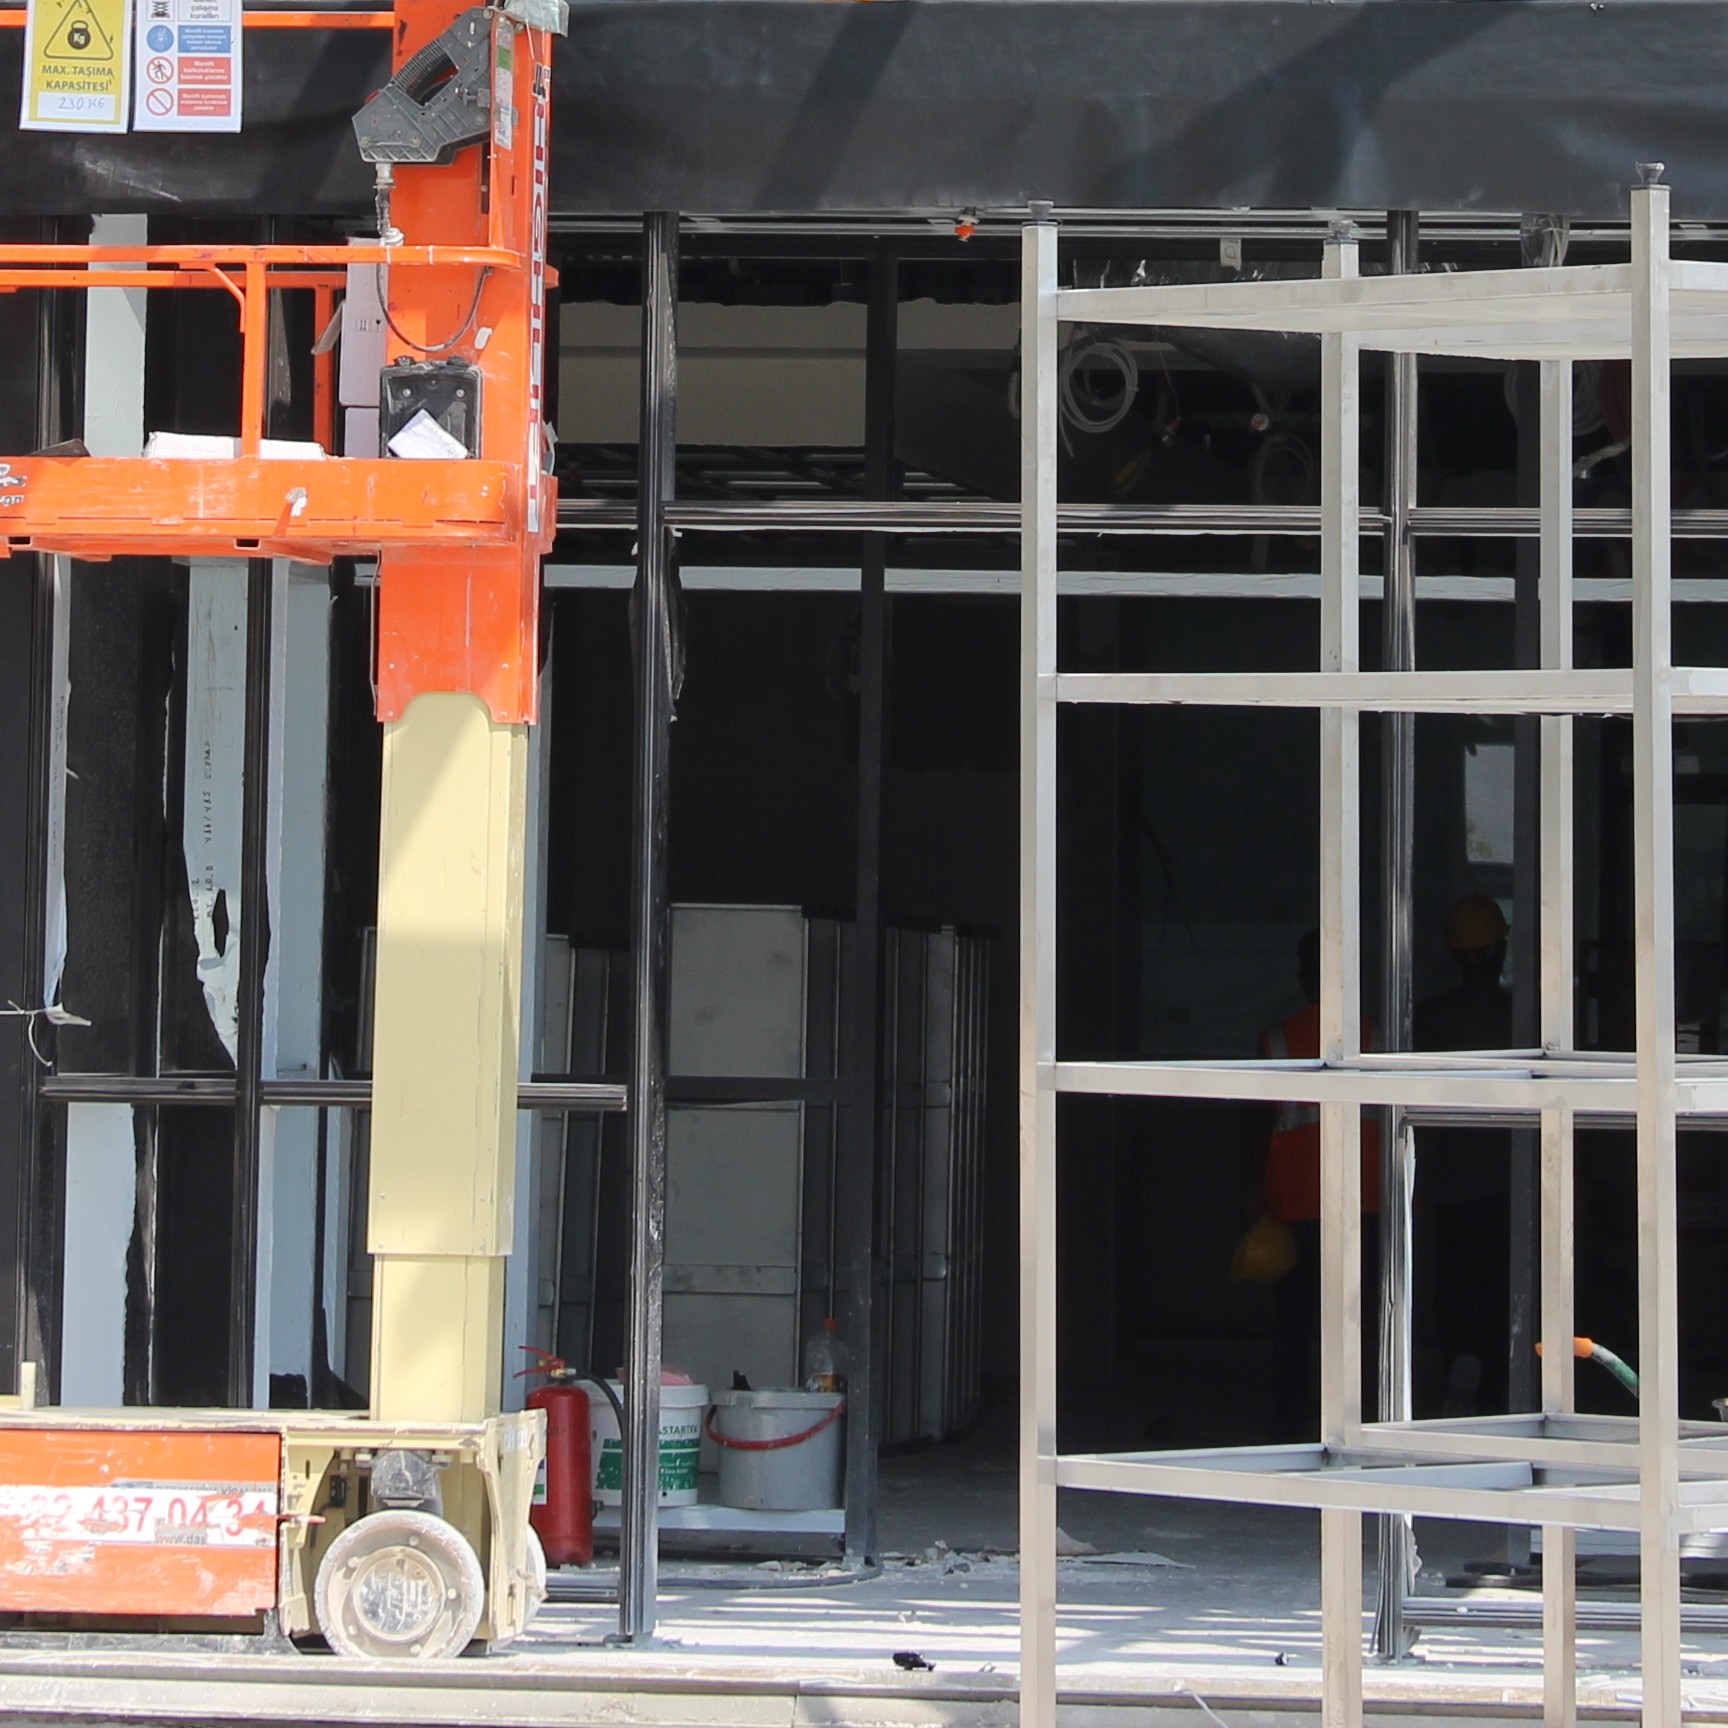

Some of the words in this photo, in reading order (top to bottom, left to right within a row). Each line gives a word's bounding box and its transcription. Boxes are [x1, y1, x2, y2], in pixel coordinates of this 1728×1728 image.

[72, 65, 114, 78] TAŞIMA
[45, 78, 109, 91] KAPASİTESİ
[57, 95, 84, 111] 230
